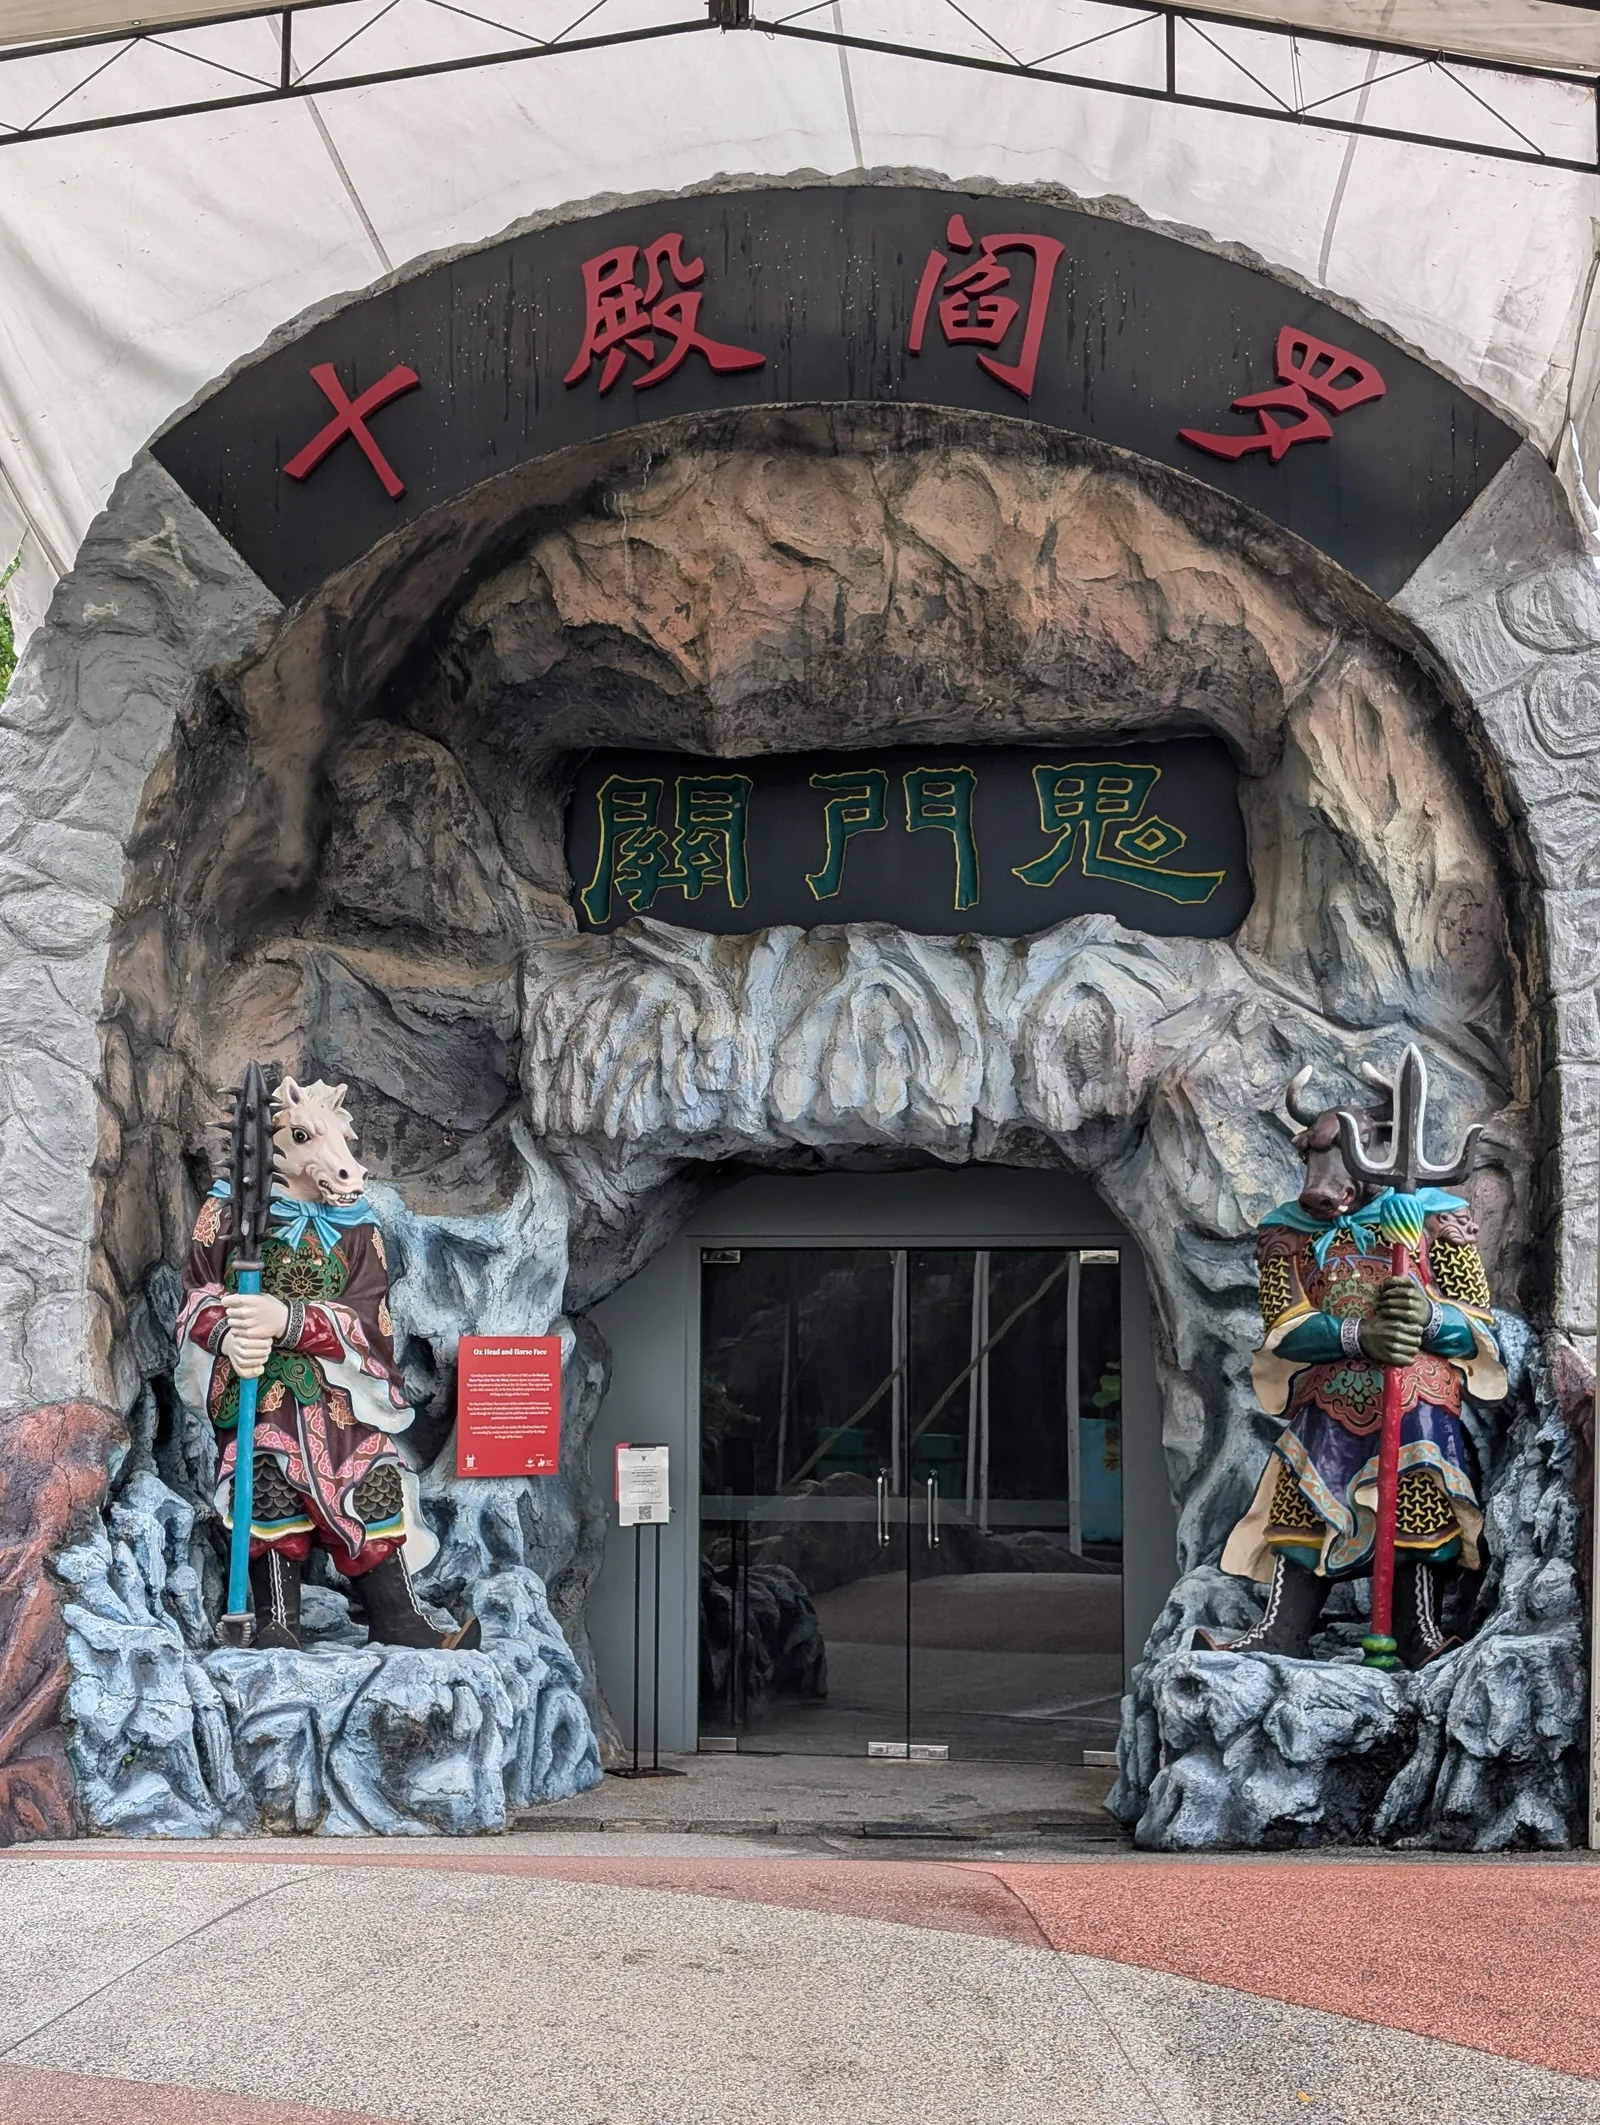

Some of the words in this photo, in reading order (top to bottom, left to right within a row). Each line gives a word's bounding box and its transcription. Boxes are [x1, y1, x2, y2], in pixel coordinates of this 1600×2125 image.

[473, 1348, 483, 1356] Ox
[484, 1348, 500, 1356] Head
[501, 1348, 513, 1356] and
[514, 1348, 532, 1356] Horse
[533, 1348, 547, 1356] Face
